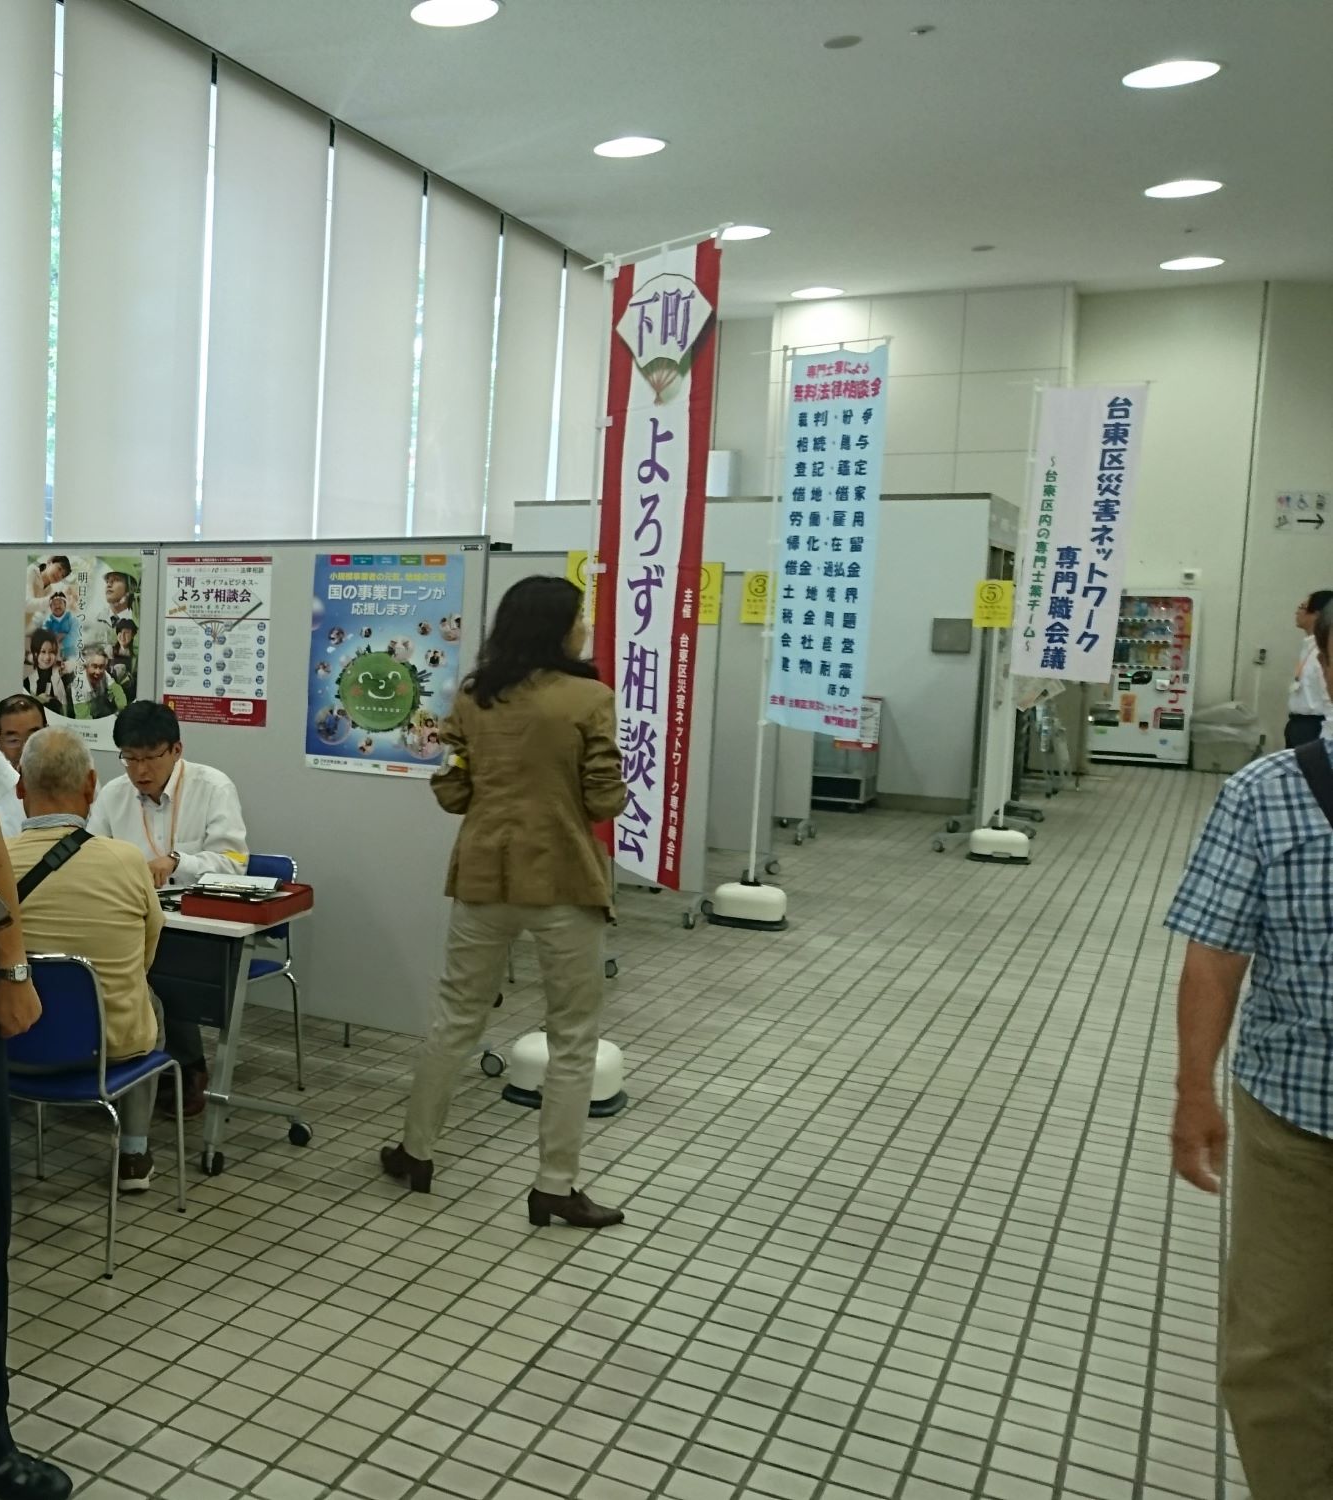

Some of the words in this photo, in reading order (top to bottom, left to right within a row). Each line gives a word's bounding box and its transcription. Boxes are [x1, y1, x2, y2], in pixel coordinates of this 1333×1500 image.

[629, 288, 696, 357] 下町
[1075, 396, 1132, 653] 台東区災害ネットワーク
[174, 576, 196, 589] 下町
[178, 588, 251, 603] よろず相談会
[328, 584, 446, 601] 国の事業ローンが
[1040, 546, 1082, 670] 専門職会議
[74, 571, 88, 702] 明日をつくる人に力を
[618, 417, 674, 863] よろず相談会
